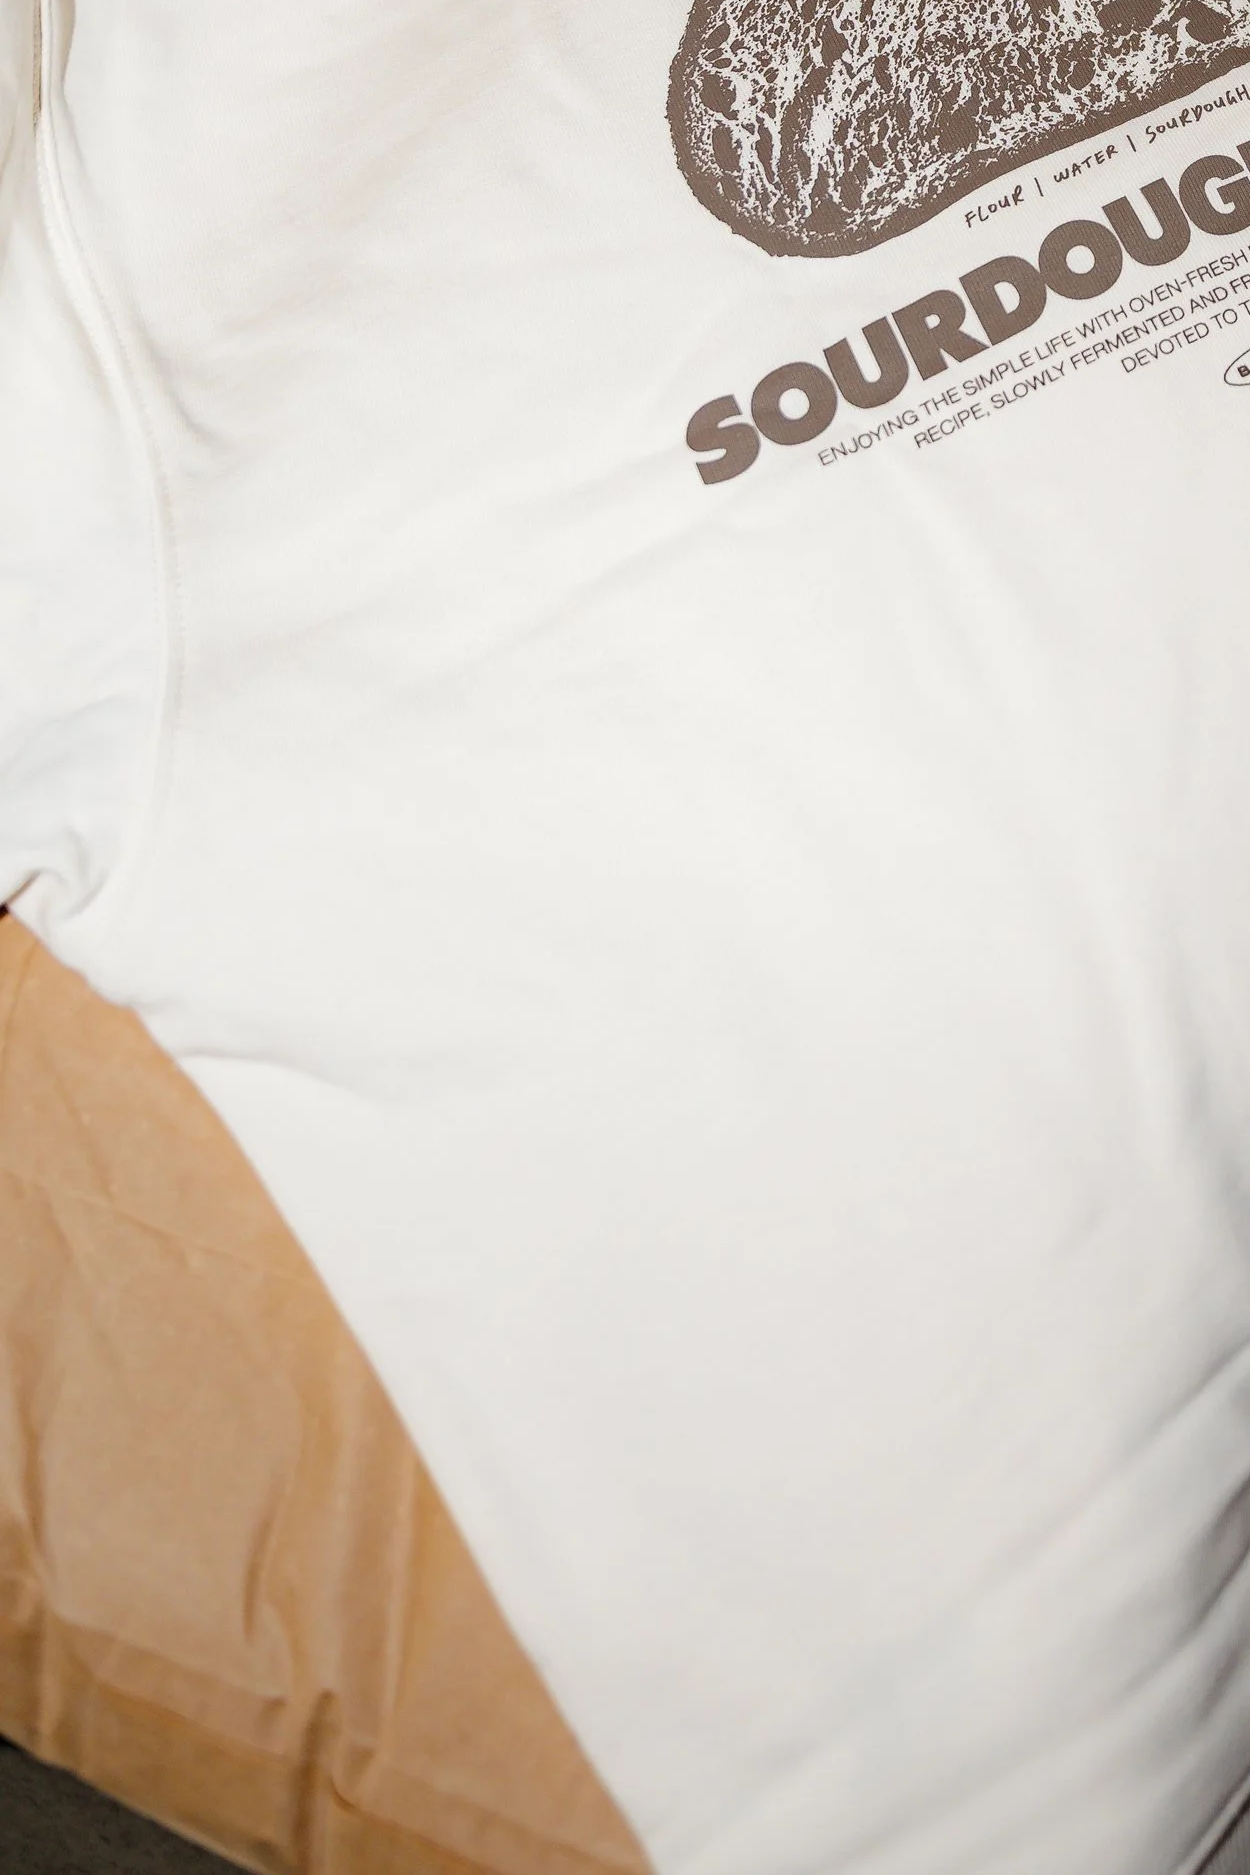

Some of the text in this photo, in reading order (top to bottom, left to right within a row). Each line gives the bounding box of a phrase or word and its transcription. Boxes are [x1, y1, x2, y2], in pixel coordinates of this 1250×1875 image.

[963, 183, 1026, 230] FLOUR
[1052, 143, 1120, 184] WATER
[817, 409, 920, 466] ENJOYING
[919, 386, 962, 416] THE
[962, 350, 1035, 397] SIMPLE
[1034, 330, 1077, 361] LIFE
[1075, 304, 1128, 339] WITH
[1128, 249, 1249, 313] OVEN-FRESH
[913, 402, 991, 449] RECIPE,
[990, 360, 1065, 410] SLOWLY
[1069, 305, 1186, 370] FERMENTED
[1190, 286, 1229, 315] AND
[1120, 322, 1210, 374] DEVOTED
[1209, 308, 1238, 330] TO
